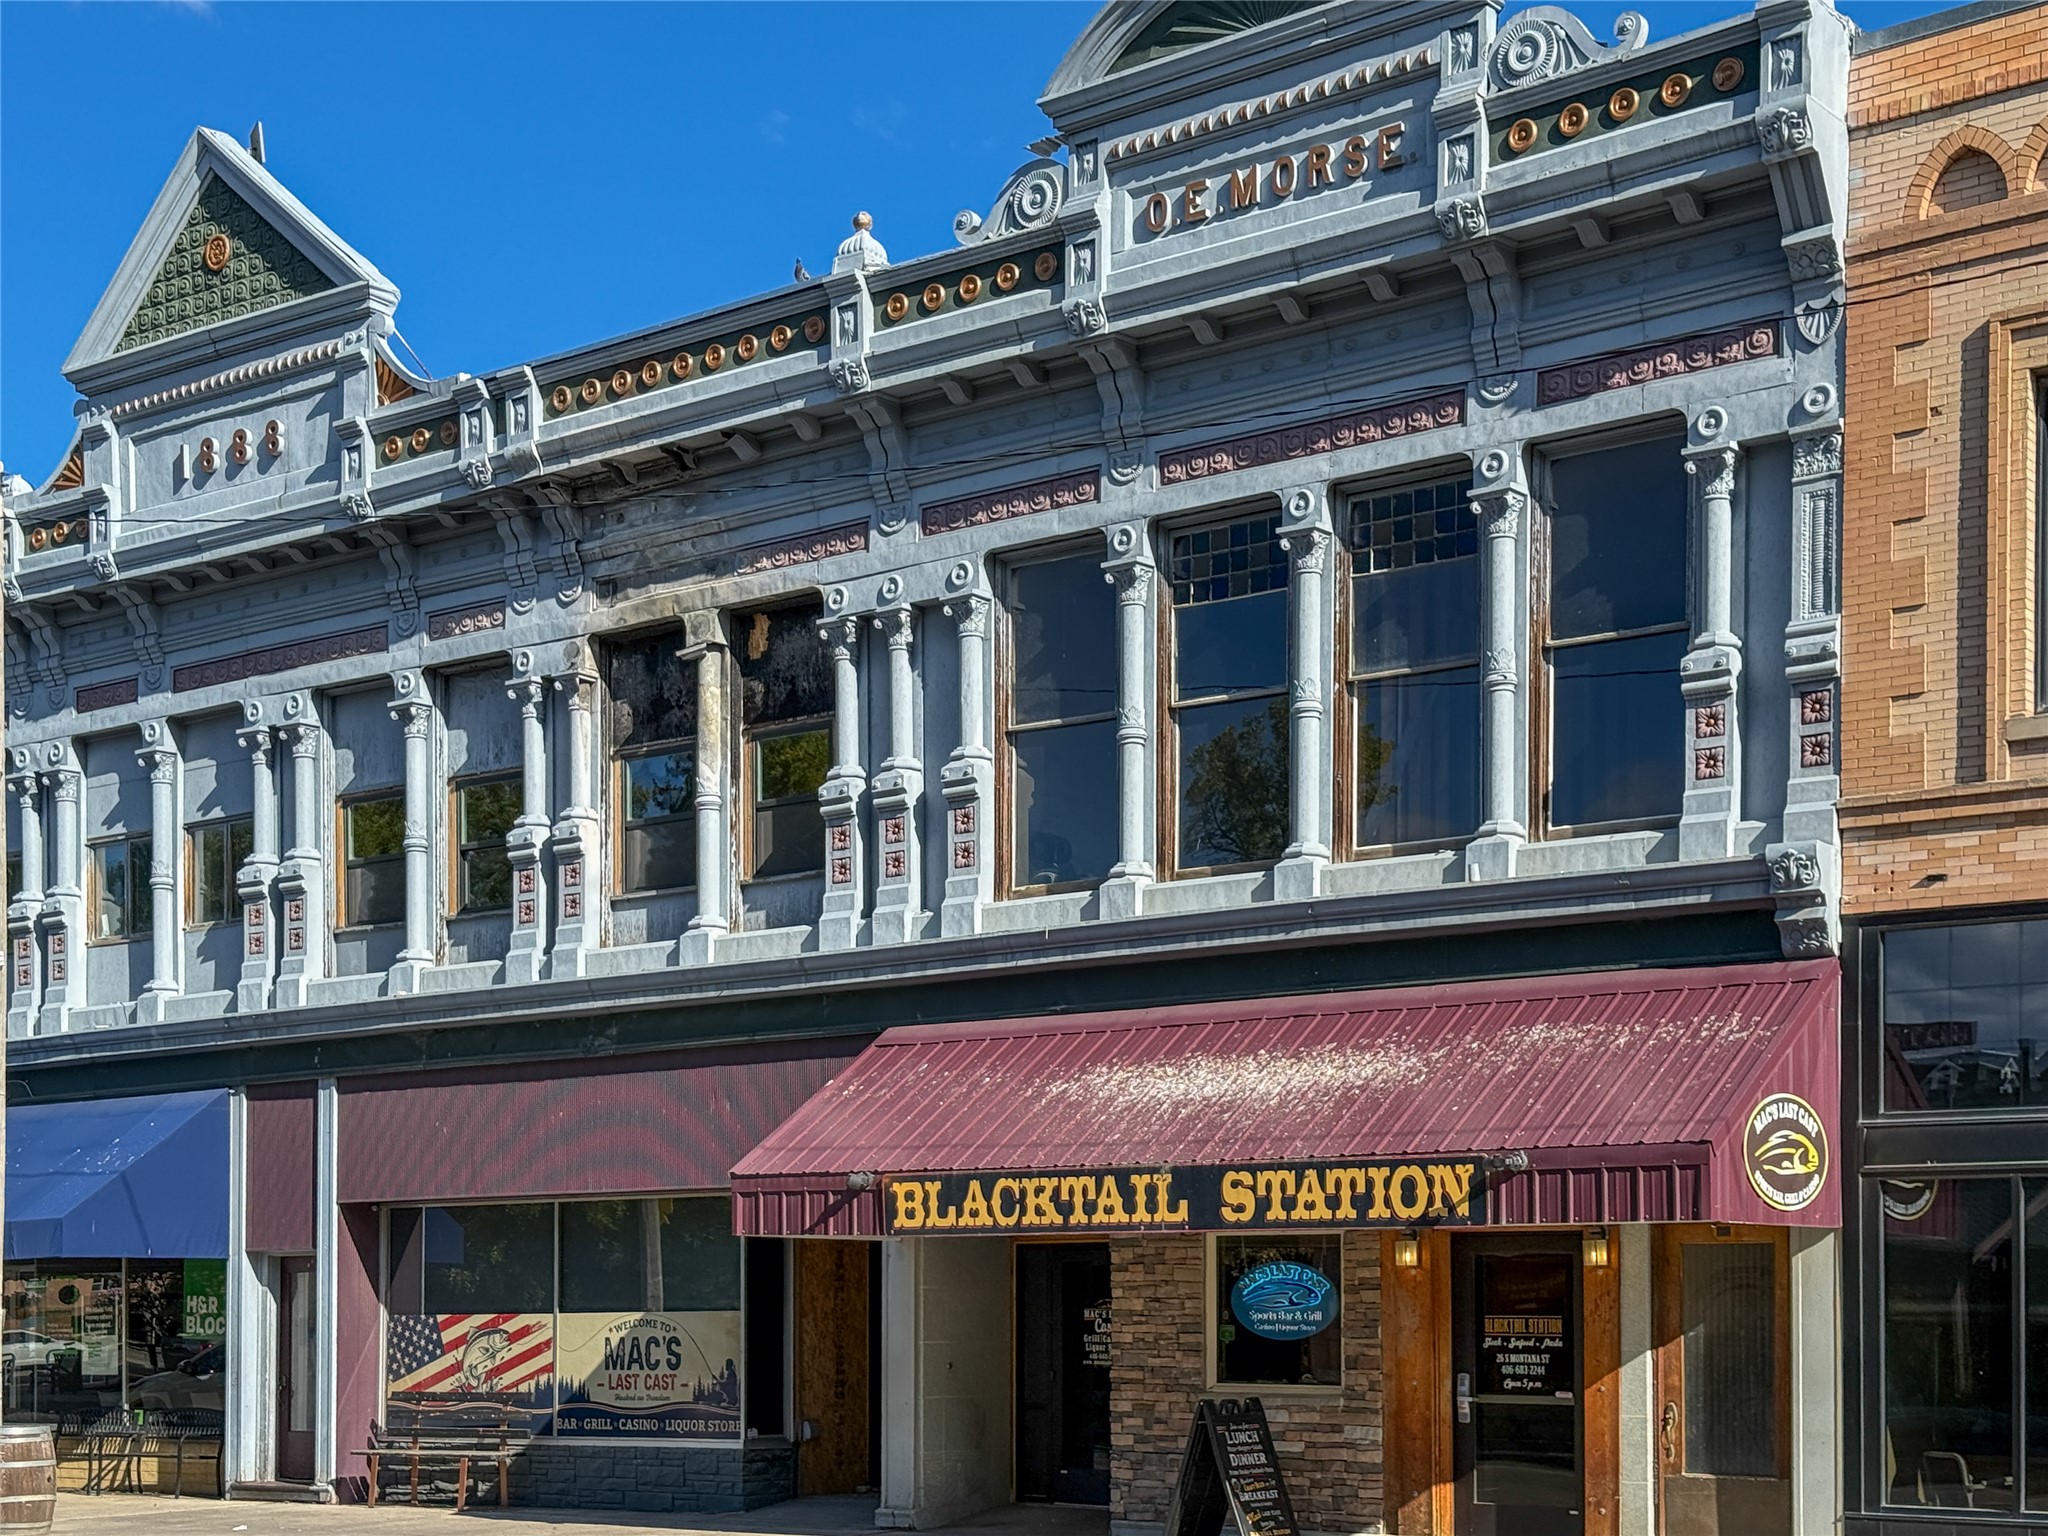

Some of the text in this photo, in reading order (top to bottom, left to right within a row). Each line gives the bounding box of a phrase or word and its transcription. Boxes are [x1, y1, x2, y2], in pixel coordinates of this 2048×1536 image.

[180, 418, 286, 480] 1888
[1753, 1102, 1819, 1138] MAC'S LAST CAST
[891, 1162, 1476, 1229] BLACKTAIL STATION
[186, 1295, 219, 1314] H&R
[1249, 1310, 1323, 1322] Sports Bar & Grill
[186, 1315, 226, 1335] BLOC
[614, 1318, 672, 1333] WELCOME TO
[1484, 1318, 1563, 1333] BLACKTAIL STATION
[604, 1335, 682, 1371] MAC'S
[1510, 1353, 1541, 1364] MONTANA
[1541, 1354, 1551, 1364] ST
[608, 1373, 678, 1391] LAST CAST
[557, 1418, 741, 1434] BAR GRILL CASINO LIQUOR STORE
[1225, 1430, 1259, 1445] LUNCH
[1229, 1452, 1268, 1467] DINNER
[1239, 1489, 1279, 1501] BREAKFAST
